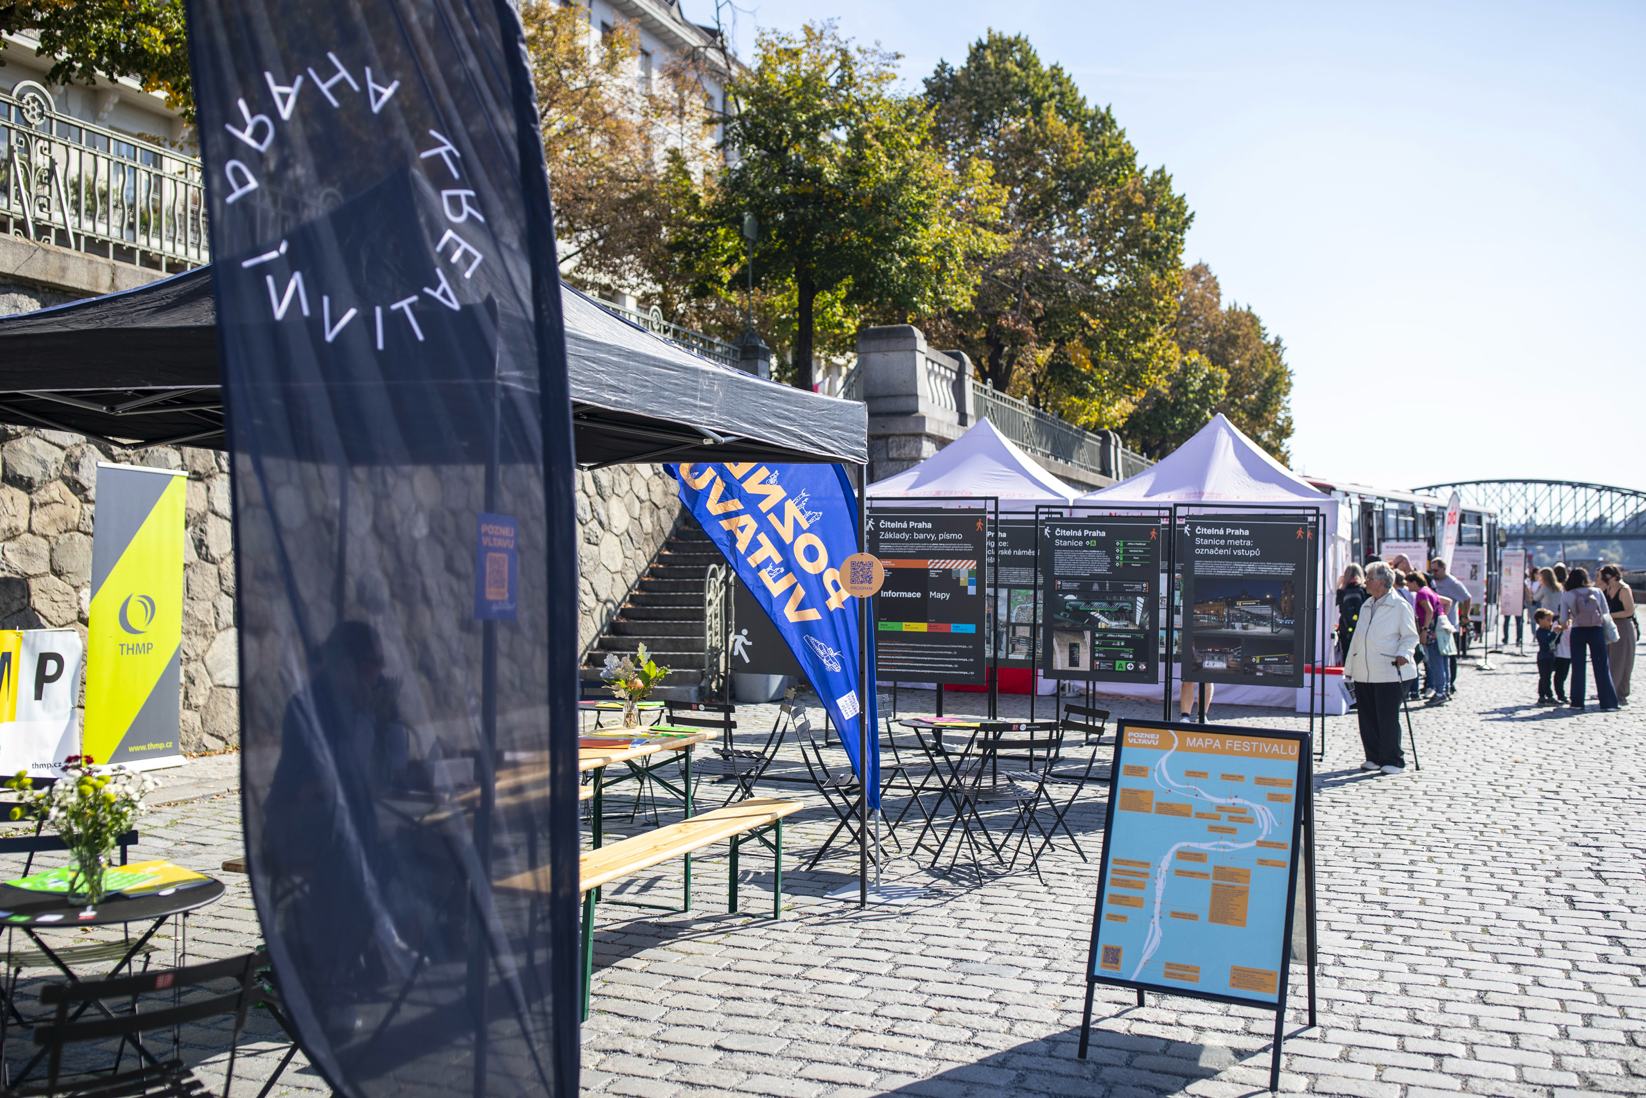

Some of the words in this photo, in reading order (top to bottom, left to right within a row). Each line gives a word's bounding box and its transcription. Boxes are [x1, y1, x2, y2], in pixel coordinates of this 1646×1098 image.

[879, 520, 908, 529] Čitelná
[909, 521, 932, 529] Praha
[481, 524, 514, 537] POZNEJ
[1054, 528, 1082, 537] Čitelná
[1083, 529, 1106, 537] Praha
[1195, 526, 1224, 535] Čitelná
[1226, 528, 1250, 536] Praha
[879, 531, 912, 541] Základy:
[913, 532, 937, 541] barvy,
[938, 532, 963, 541] písmo
[1195, 537, 1225, 545] Stanice
[482, 536, 514, 548] VLTAVU
[1054, 538, 1083, 547] Stanice
[1195, 547, 1231, 556] označení
[1233, 548, 1261, 557] vstupů
[880, 590, 922, 598] Informace
[929, 591, 951, 601] Mapy
[118, 643, 154, 656] THMP
[1127, 731, 1160, 739] POZNEJ
[128, 741, 173, 753] www.thmp.cz
[1127, 738, 1159, 746] VLTAVU
[1186, 737, 1221, 750] MAPA
[1226, 740, 1298, 756] FESTIVALU
[32, 760, 62, 770] thmp.cz
